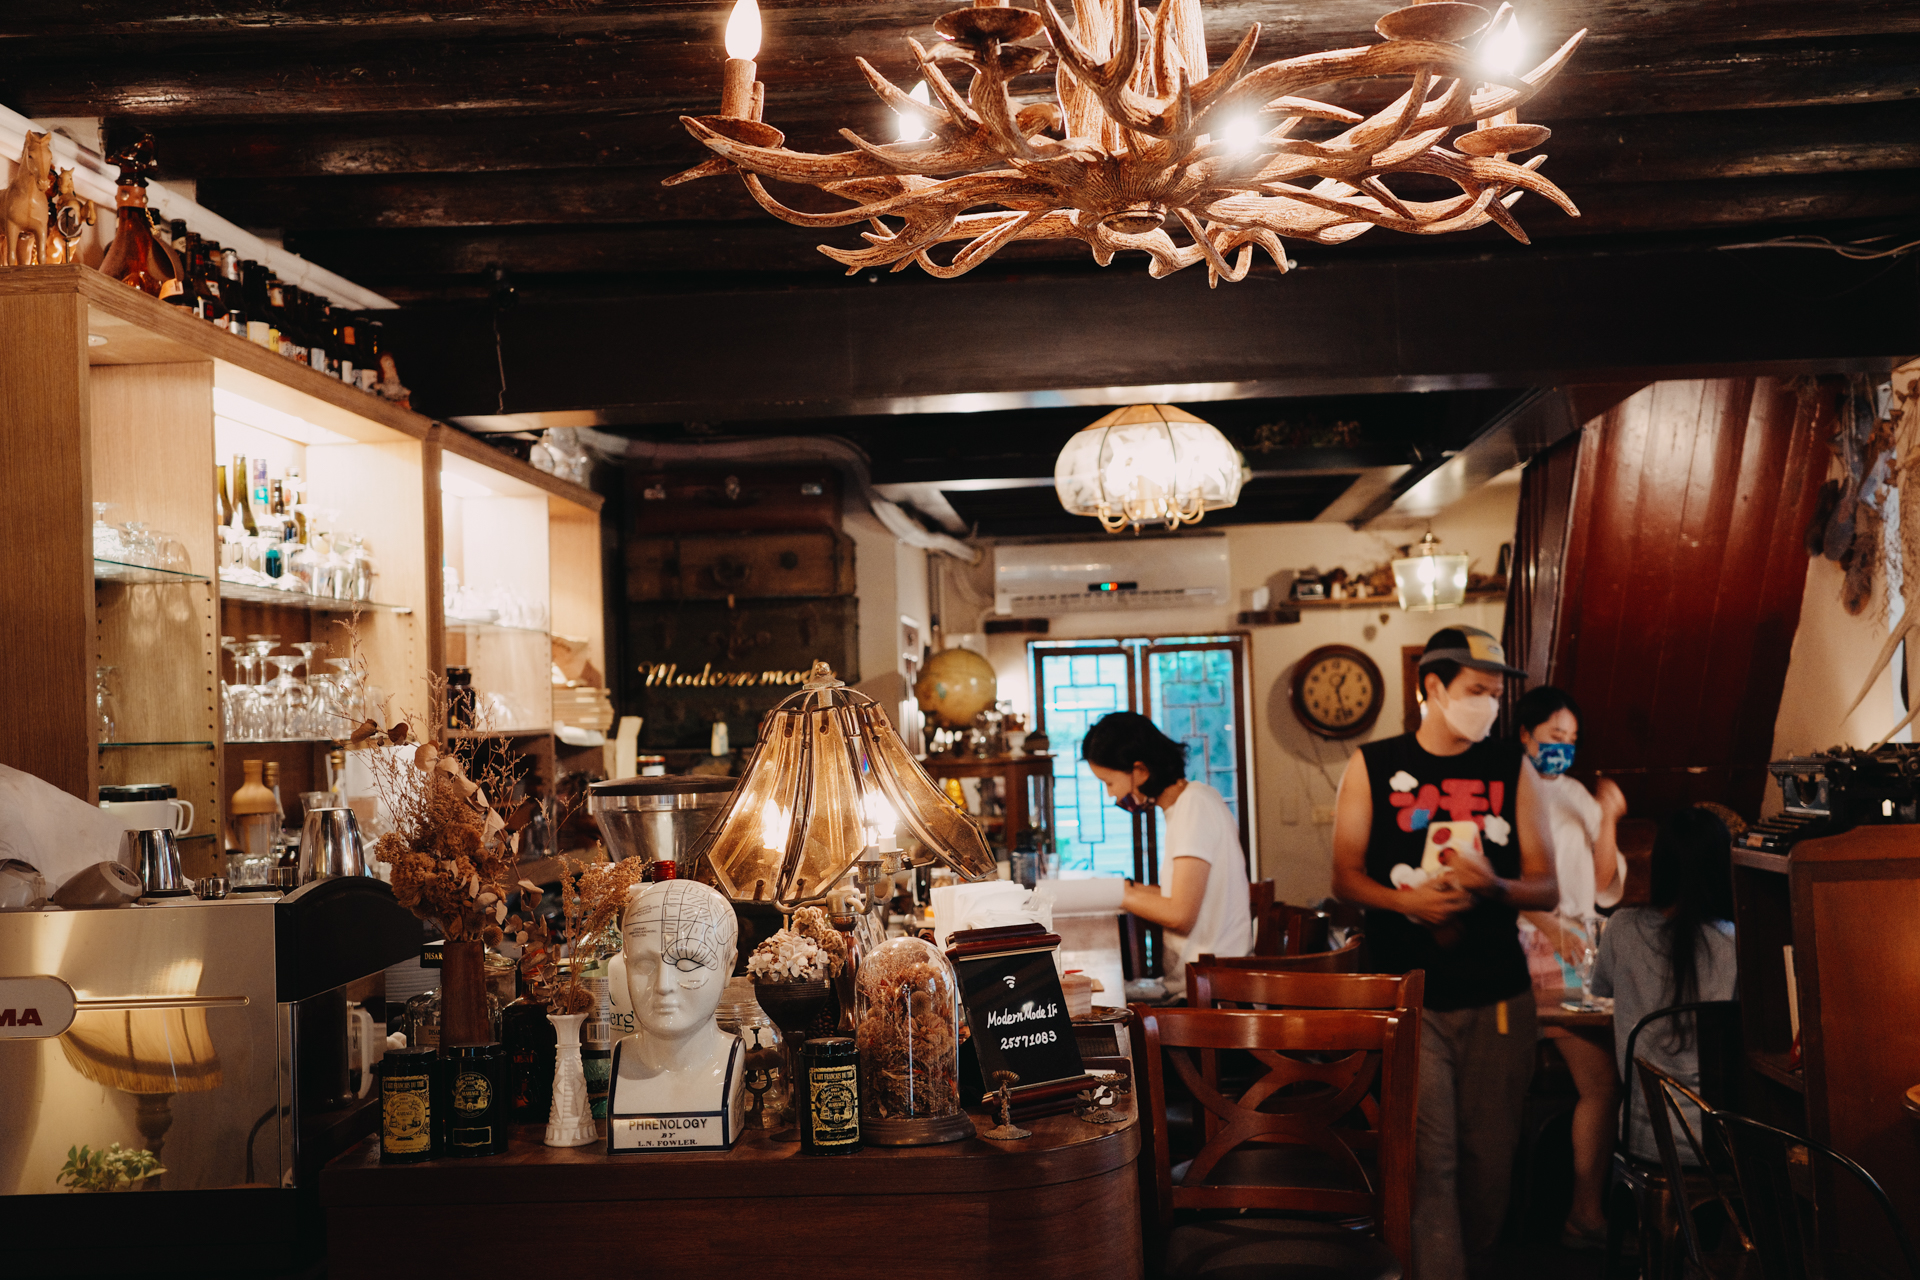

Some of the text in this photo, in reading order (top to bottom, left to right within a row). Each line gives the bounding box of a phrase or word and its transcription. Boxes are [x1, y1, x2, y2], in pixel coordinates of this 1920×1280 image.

[638, 659, 838, 688] Modern mod
[1000, 1030, 1057, 1050] 25571083
[628, 1118, 707, 1130] PHRENOLOGY
[657, 1139, 698, 1147] FOWLER.
